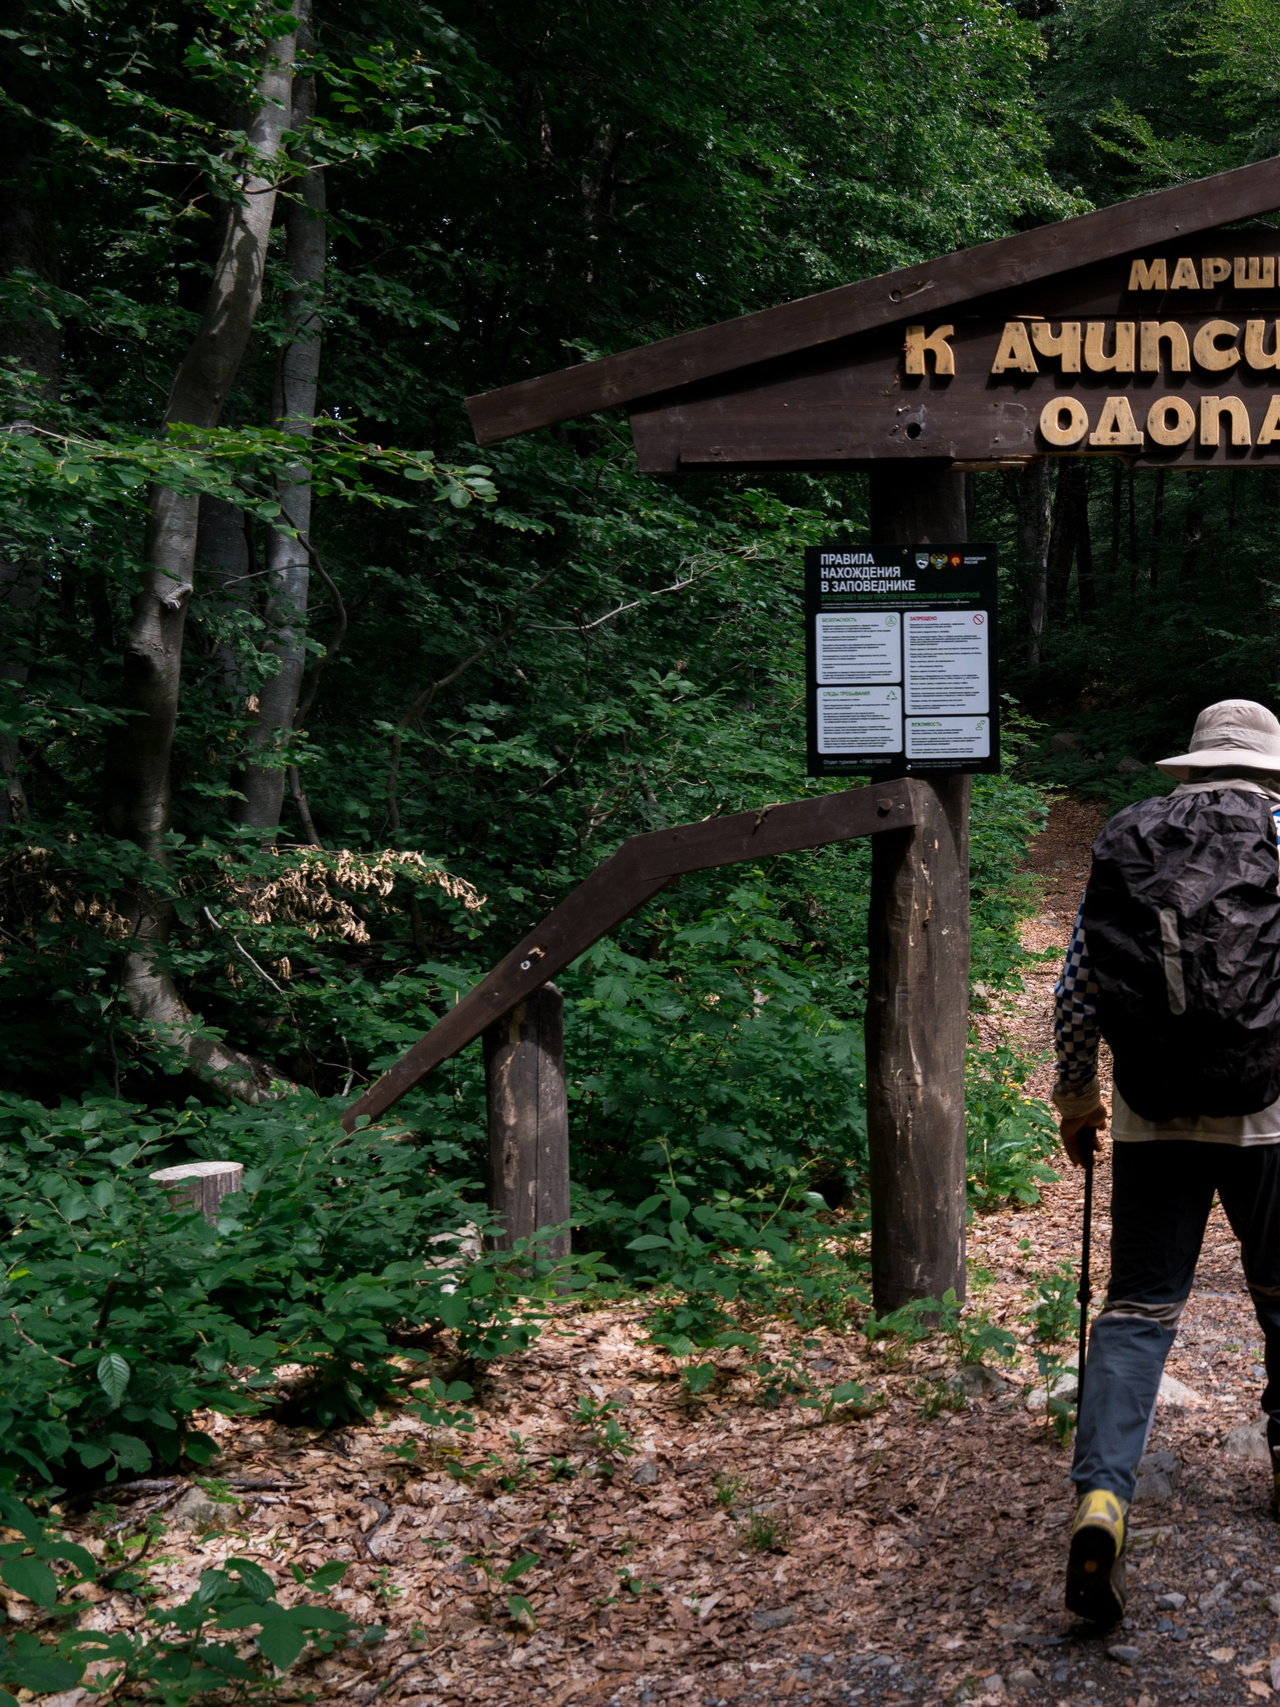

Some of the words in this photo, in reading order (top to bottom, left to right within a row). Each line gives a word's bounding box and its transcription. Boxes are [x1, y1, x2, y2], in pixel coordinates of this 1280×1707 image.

[905, 324, 955, 377] К
[821, 553, 874, 565] ПРАВИЛА
[821, 566, 901, 580] НАХОЖДЕНИЯ
[821, 581, 830, 592] В
[832, 580, 916, 593] ЗАПОВЕДНИКЕ
